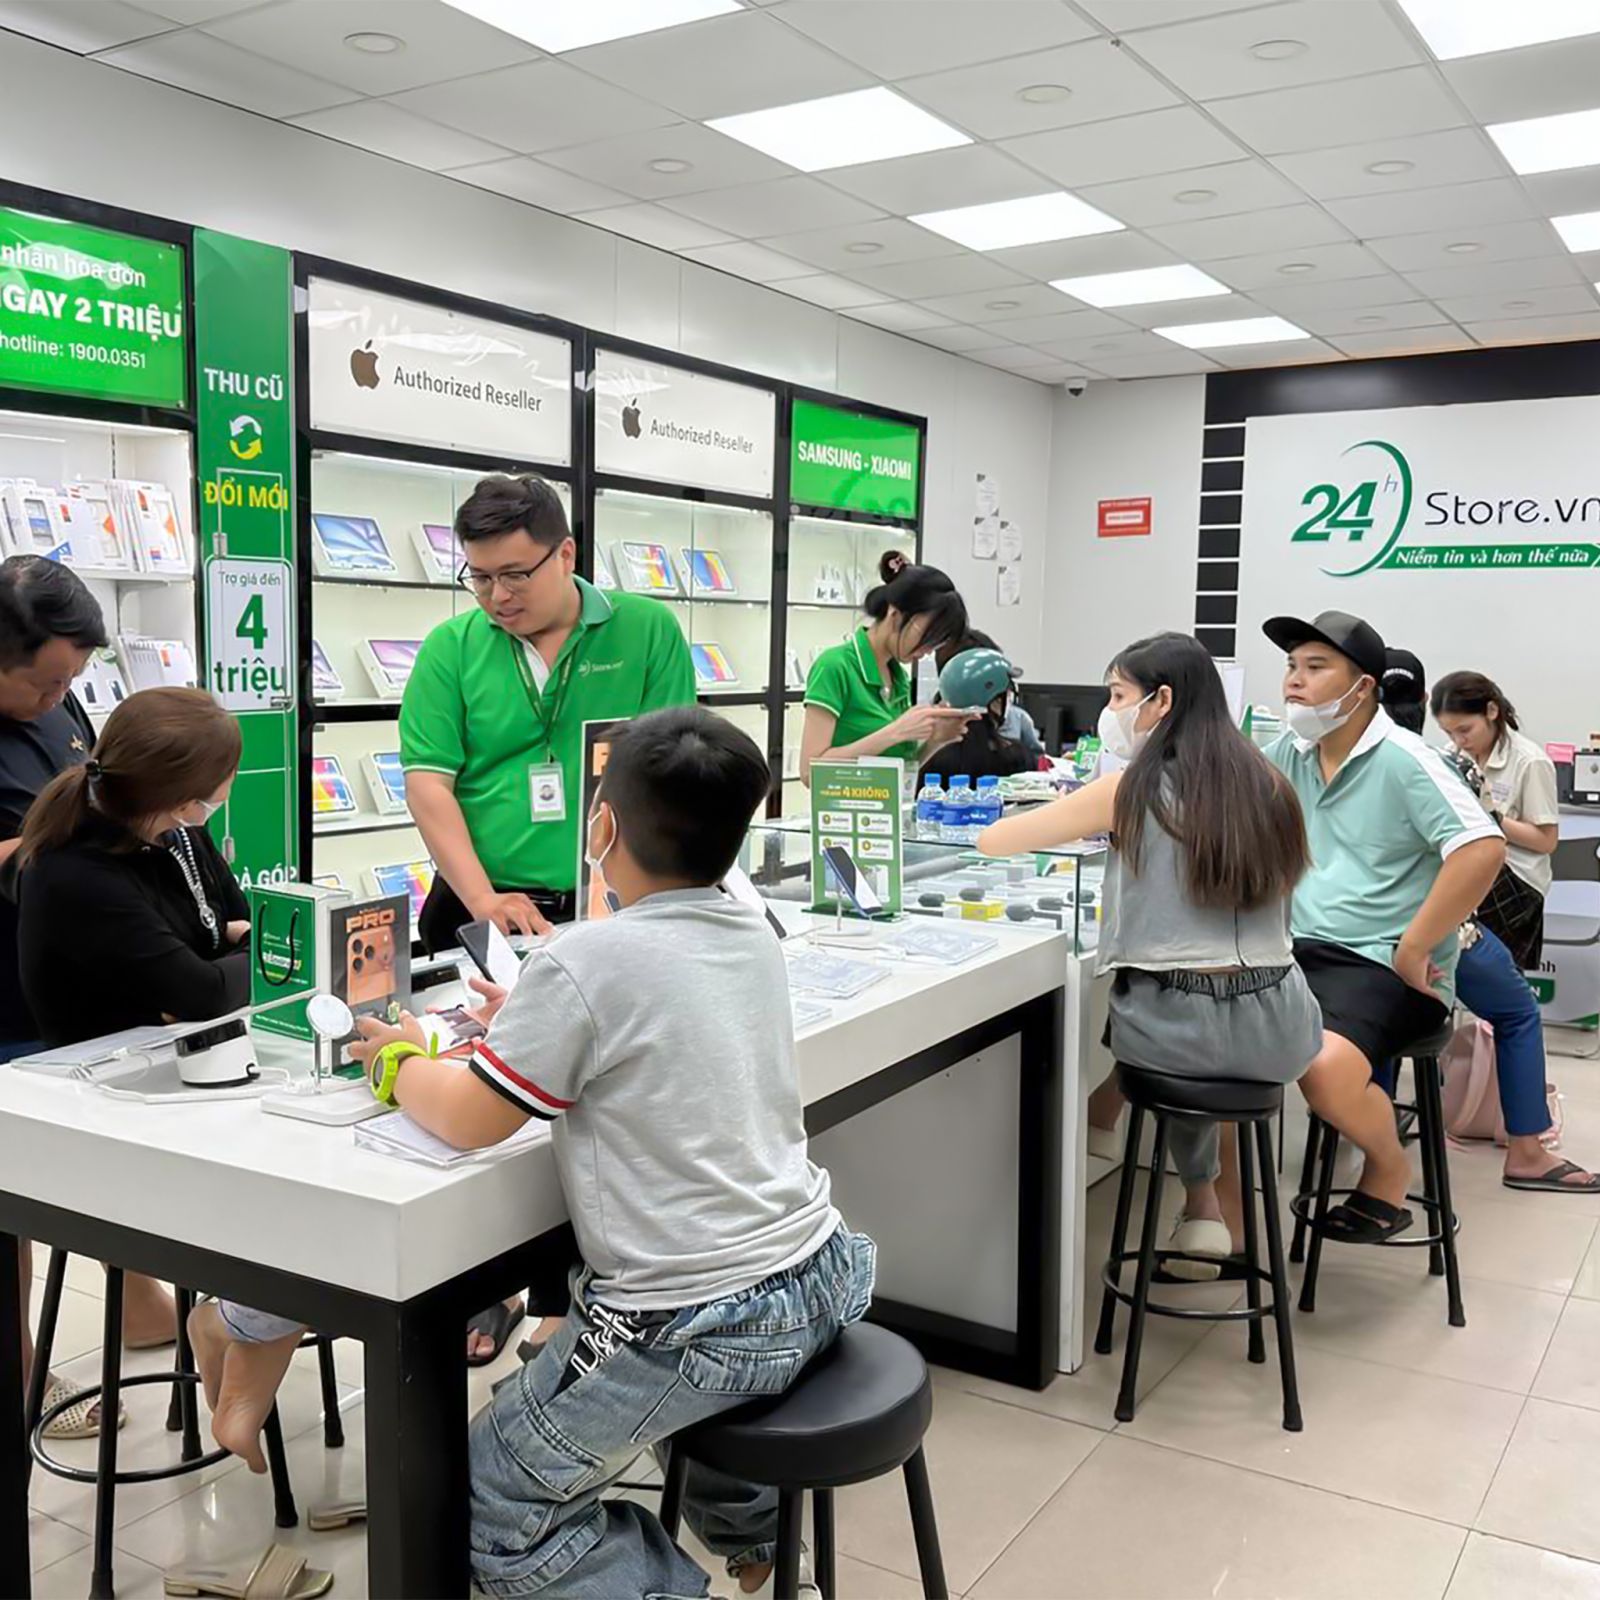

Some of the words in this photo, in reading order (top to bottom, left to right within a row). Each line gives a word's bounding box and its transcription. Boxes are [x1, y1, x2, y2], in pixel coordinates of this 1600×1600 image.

[0, 284, 67, 319] GAY
[74, 296, 93, 324] 2
[97, 301, 182, 341] TRIỆU
[0, 329, 64, 357] hotline:
[68, 342, 146, 369] 1900.0351
[204, 367, 249, 396] THU
[255, 374, 284, 401] CŨ
[394, 366, 481, 400] Authorized
[485, 384, 542, 412] Reseller
[650, 418, 712, 446] Authorized
[713, 431, 753, 454] Reseller
[798, 440, 862, 471] SAMSUNG
[870, 454, 912, 481] XIAOMI
[204, 476, 243, 507] ĐỔI
[249, 482, 289, 510] MỚI
[1425, 491, 1600, 526] Store.vn
[1443, 548, 1465, 564] tin
[1470, 549, 1487, 564] và
[1491, 548, 1521, 564] hơn
[1528, 546, 1559, 564] thế
[236, 594, 268, 650] 4
[214, 656, 285, 700] triệu
[346, 908, 395, 933] PRO
